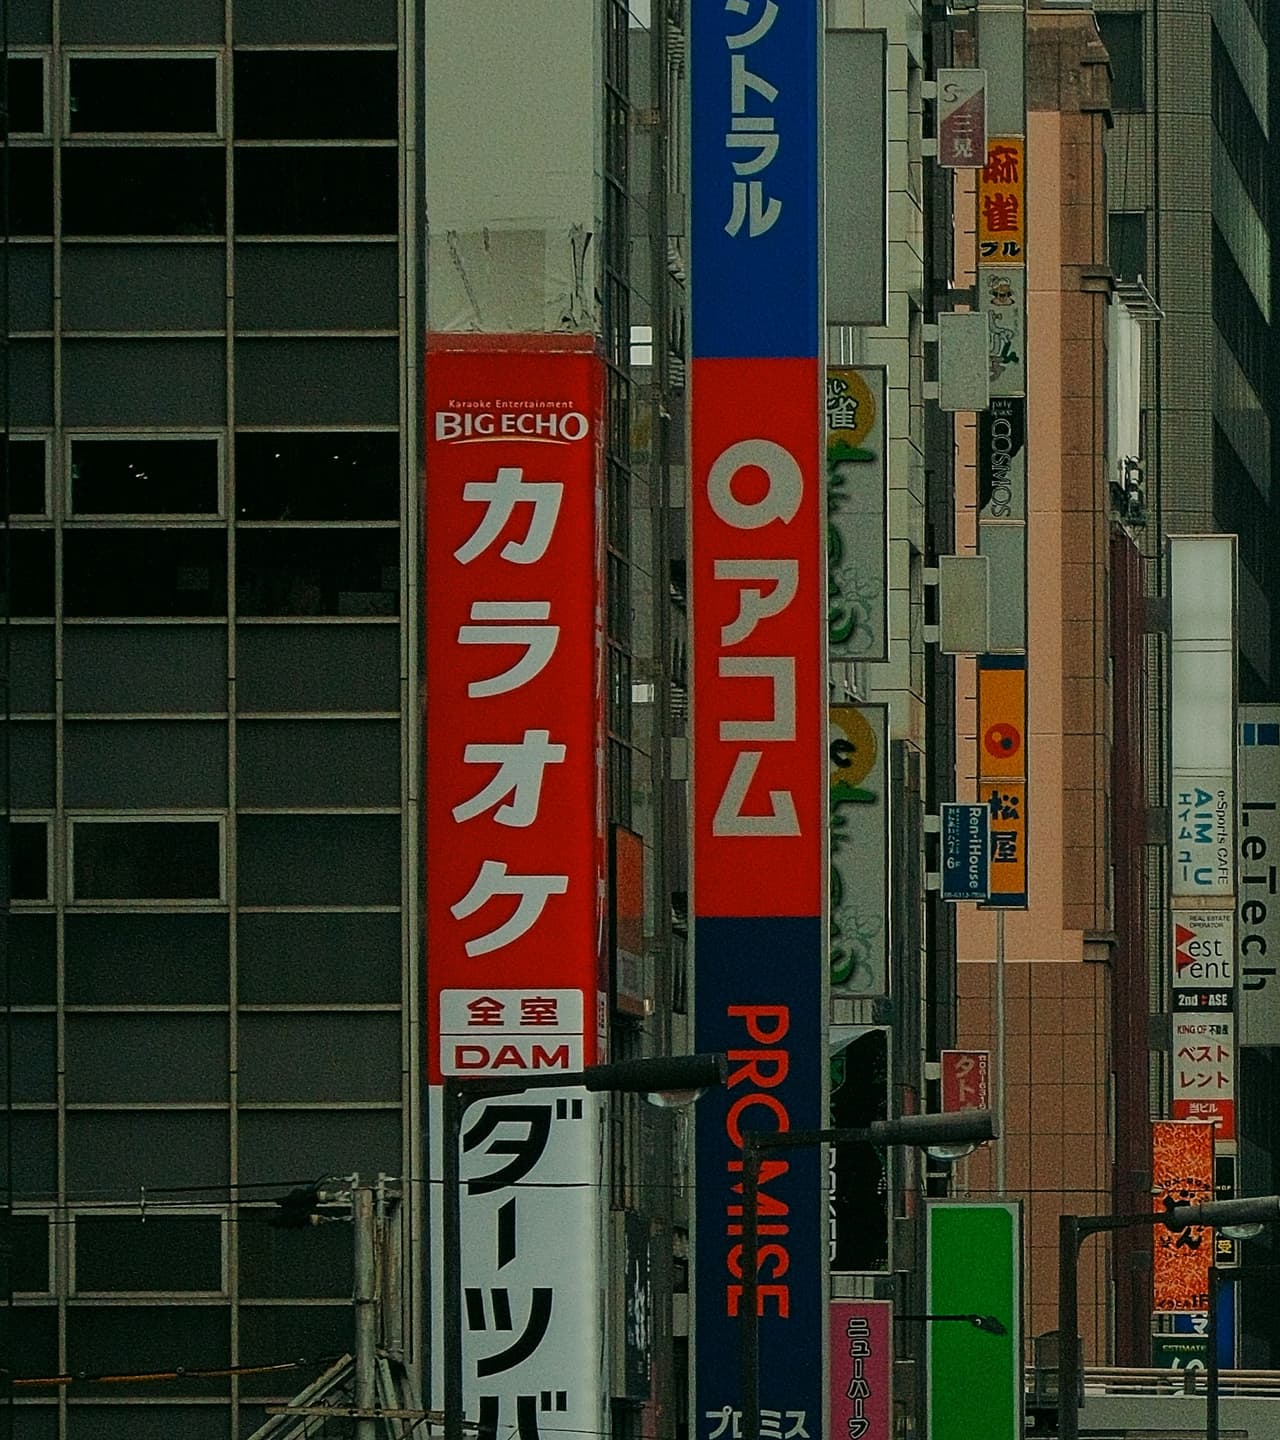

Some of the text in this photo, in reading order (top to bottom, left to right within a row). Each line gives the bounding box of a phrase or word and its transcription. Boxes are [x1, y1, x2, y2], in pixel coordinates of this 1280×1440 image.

[982, 145, 1020, 233] 麻雀
[448, 398, 575, 409] Karaoke Entertainment
[435, 410, 589, 441] BIG ECHO
[452, 466, 569, 958] カラオケ
[713, 558, 802, 838] アコム
[989, 791, 1019, 863] 松屋
[1194, 788, 1213, 844] AIM
[467, 996, 559, 1026] 全室
[455, 1044, 570, 1069] DAM
[1178, 1046, 1229, 1062] ベスト
[1179, 1071, 1229, 1089] レント
